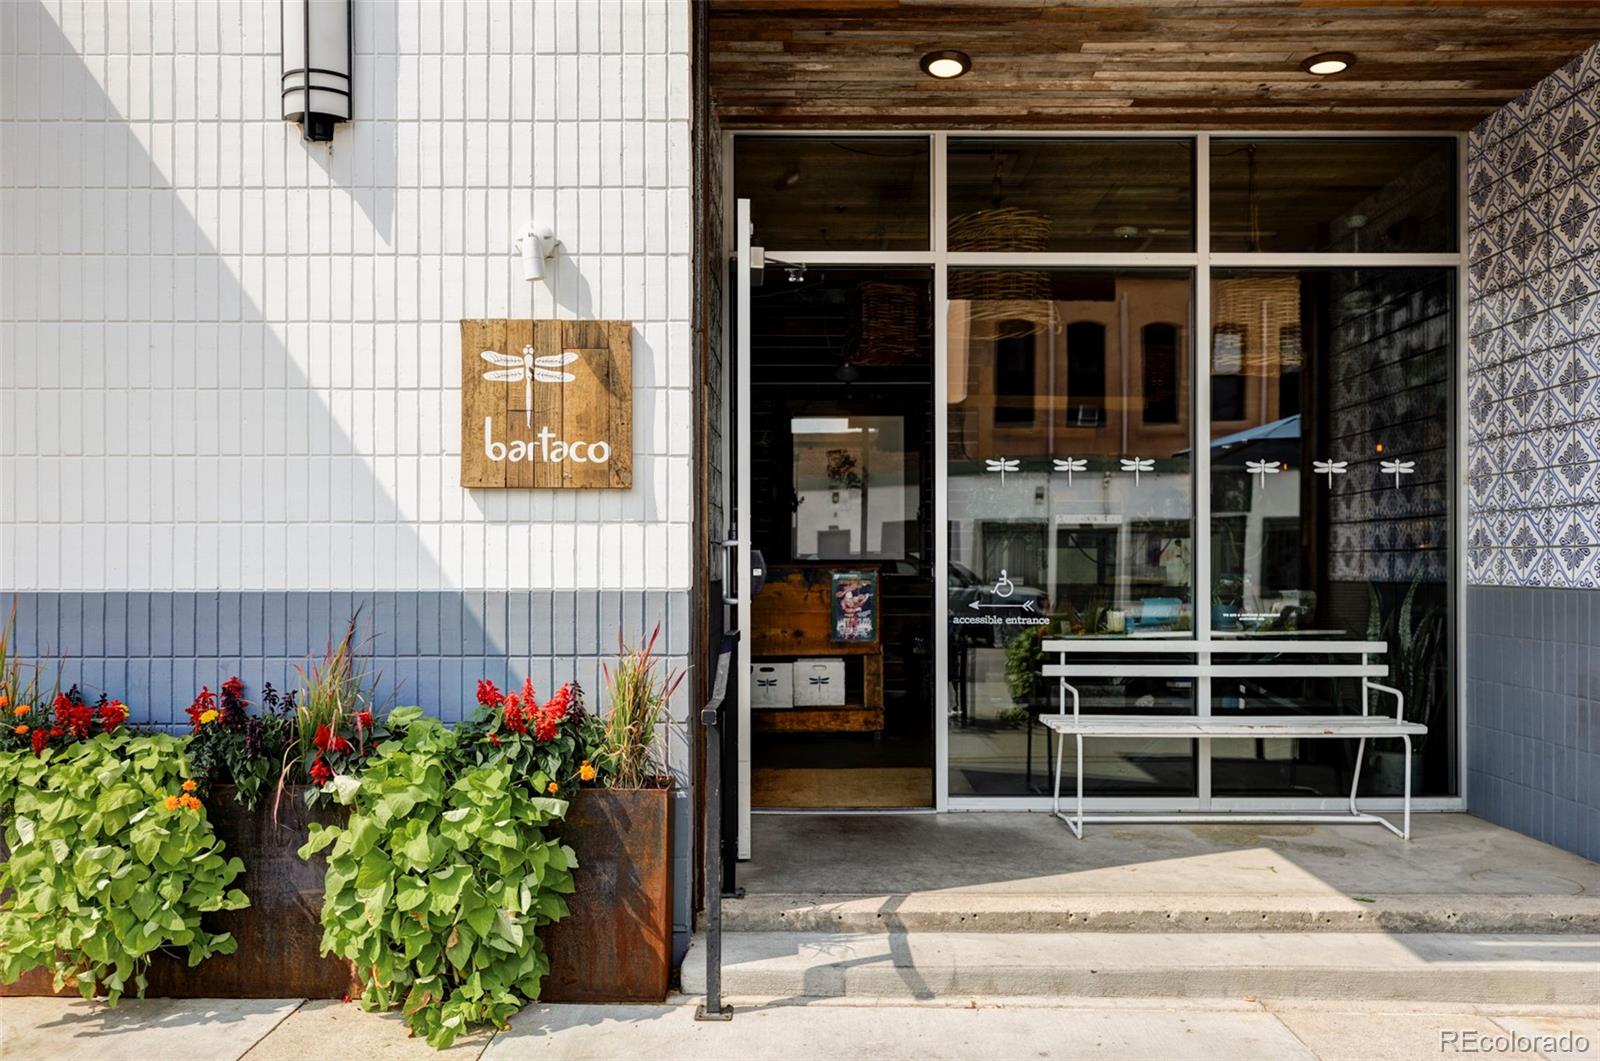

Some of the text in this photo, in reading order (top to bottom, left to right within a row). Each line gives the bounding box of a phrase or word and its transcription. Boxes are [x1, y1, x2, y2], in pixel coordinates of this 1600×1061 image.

[484, 416, 611, 463] bartaco
[952, 614, 1051, 625] accessible entrance
